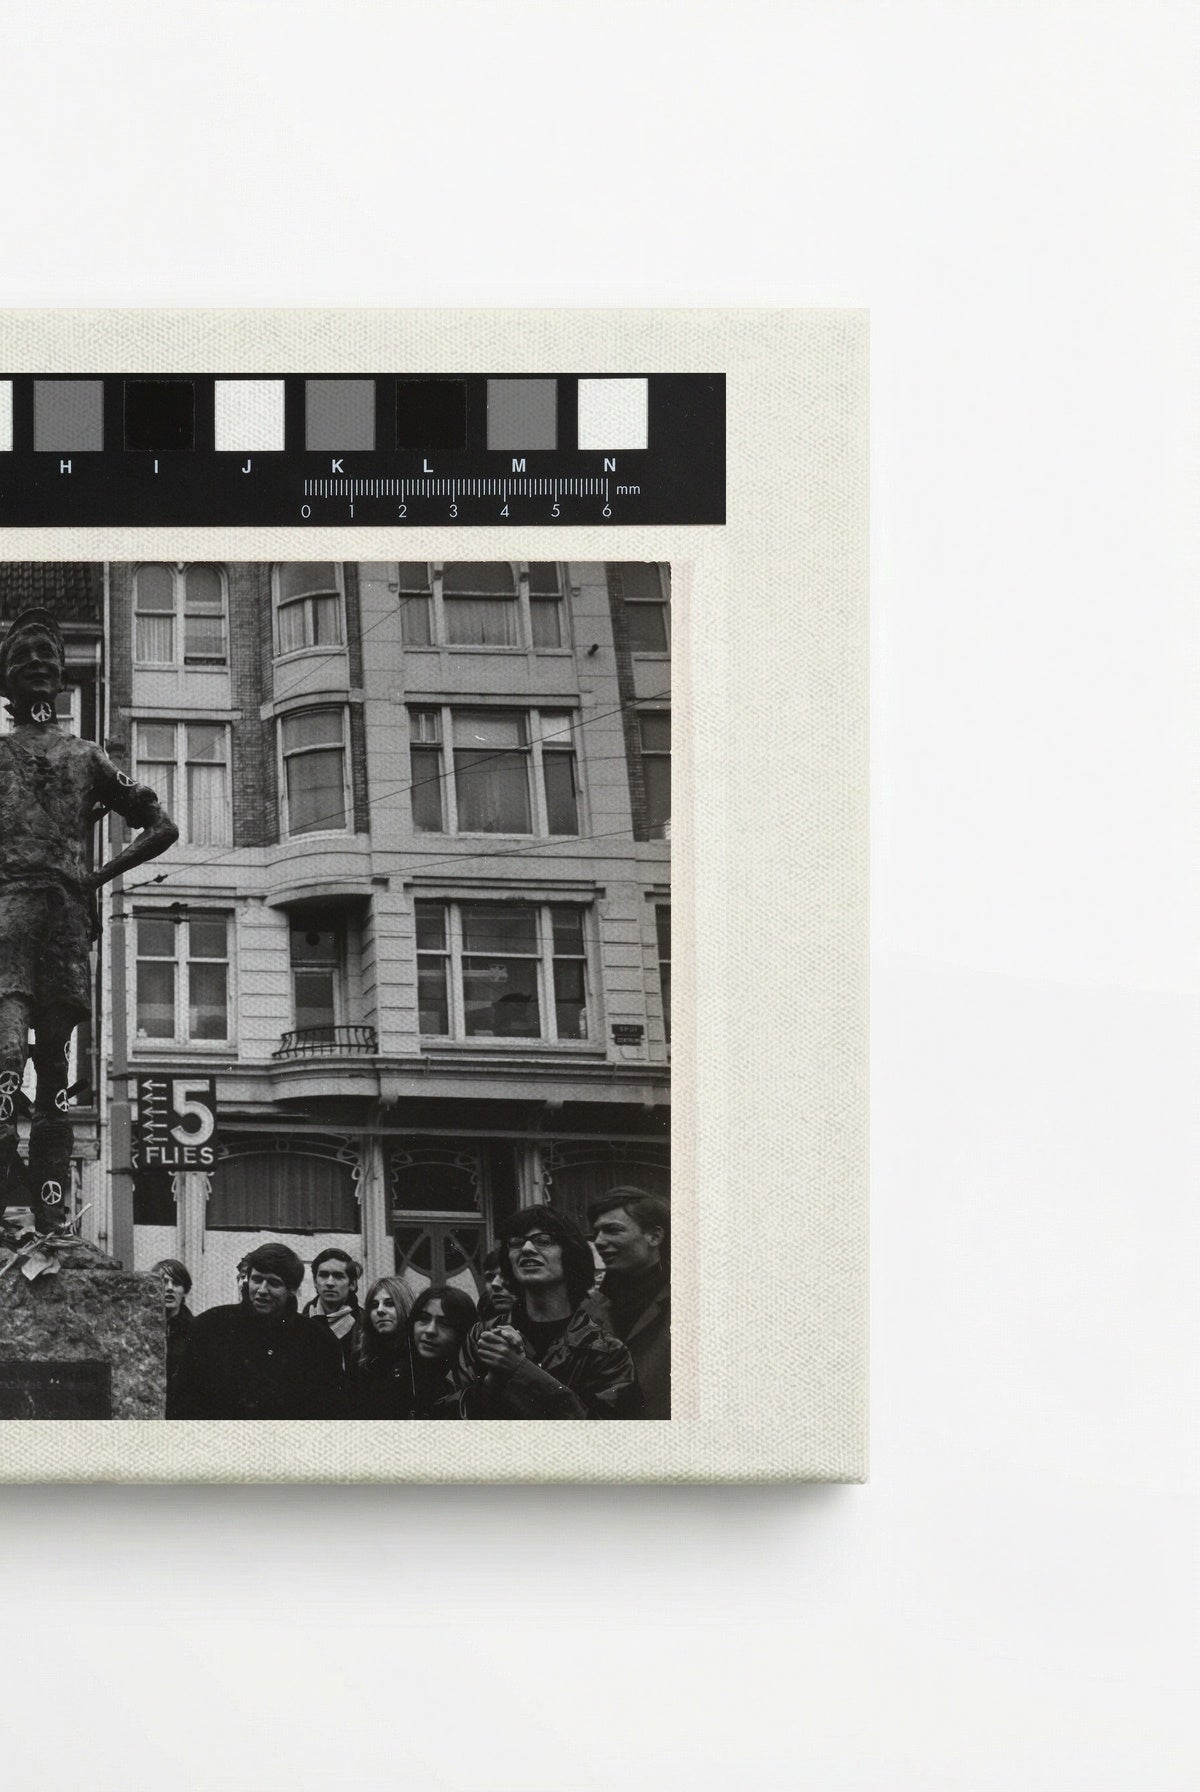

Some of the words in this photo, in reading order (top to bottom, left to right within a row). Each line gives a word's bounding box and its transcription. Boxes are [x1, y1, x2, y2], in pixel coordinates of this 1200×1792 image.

[60, 460, 73, 474] H
[153, 460, 160, 474] I
[241, 460, 253, 474] J
[331, 459, 345, 474] K
[423, 459, 435, 473] L
[511, 459, 527, 473] M
[603, 458, 617, 472] N
[616, 485, 641, 495] mm
[300, 503, 311, 518] 0
[398, 503, 407, 518] 2
[449, 503, 458, 518] 3
[499, 503, 510, 518] 4
[550, 503, 561, 518] 5
[602, 503, 612, 518] 6
[170, 1080, 214, 1146] 5
[146, 1146, 214, 1164] FLIES
